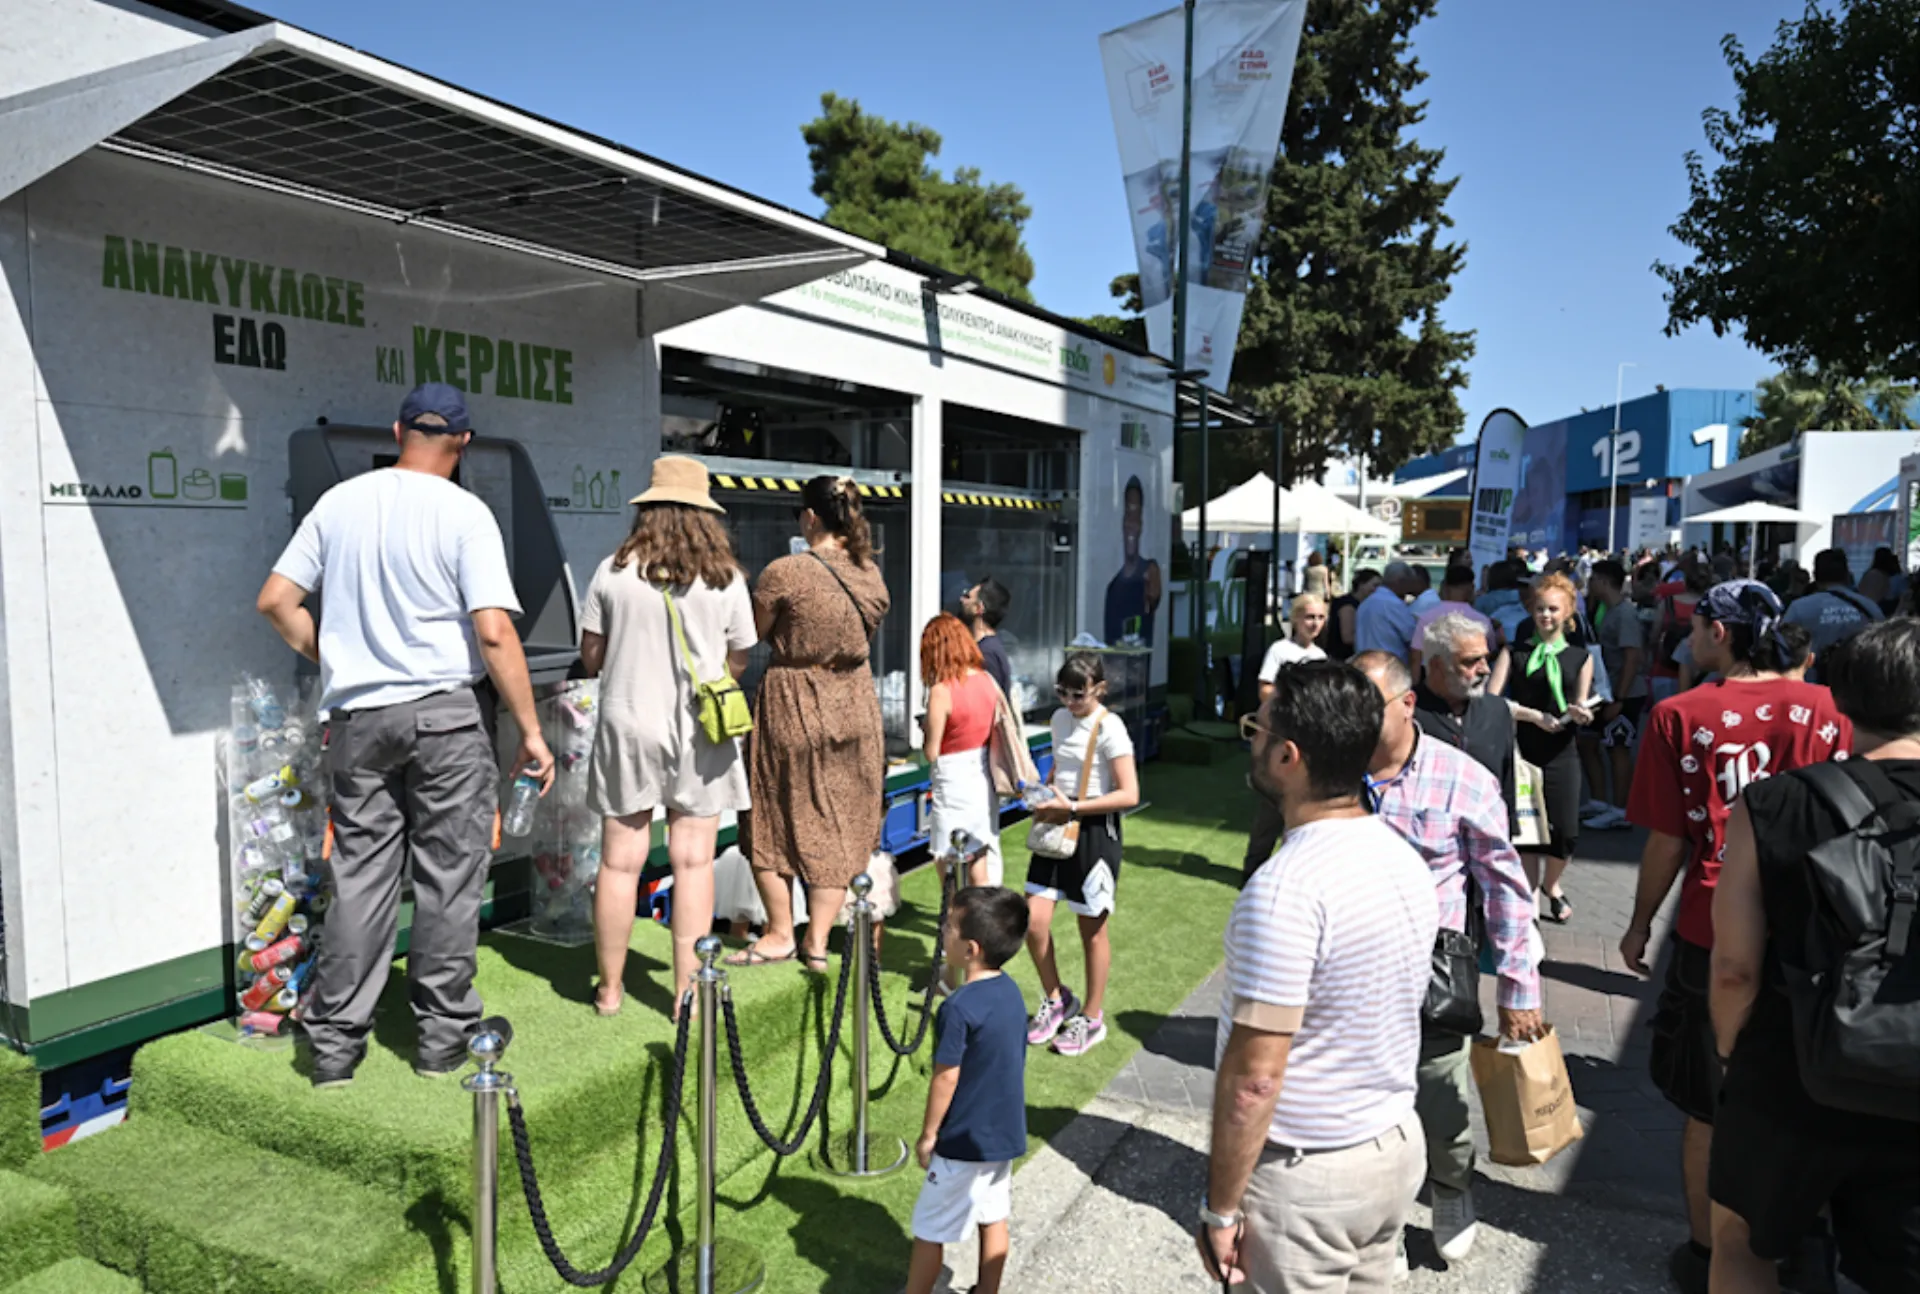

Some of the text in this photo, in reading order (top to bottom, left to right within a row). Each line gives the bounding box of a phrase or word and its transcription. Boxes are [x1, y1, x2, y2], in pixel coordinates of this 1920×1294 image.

[102, 234, 365, 328] ΑΝΑΚΥΚΛΩΣΕ
[213, 313, 286, 371] ΕΔΩ
[376, 325, 573, 405] ΚΑΙ ΚΕΡΔΙΣΕ
[1592, 429, 1641, 478] 12
[1692, 423, 1749, 469] 1
[50, 482, 142, 499] ΜΕΤΑΛΛΟ
